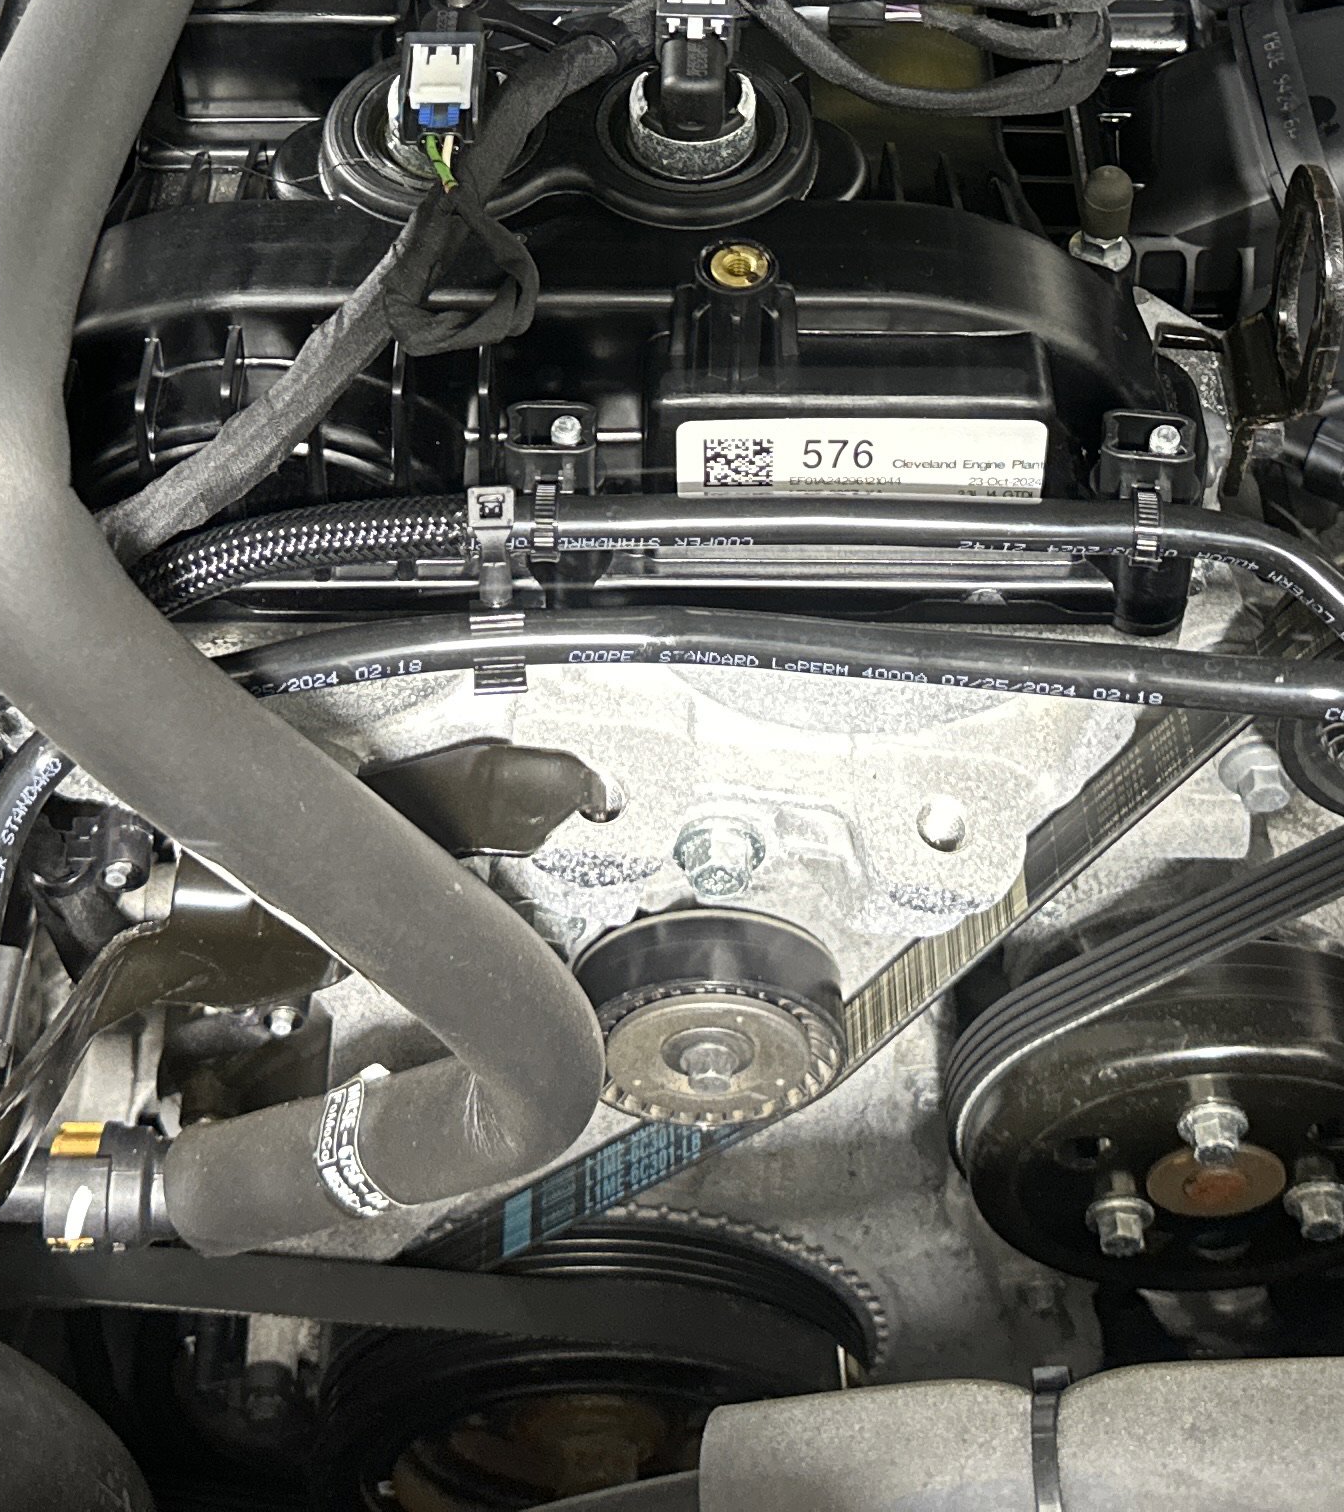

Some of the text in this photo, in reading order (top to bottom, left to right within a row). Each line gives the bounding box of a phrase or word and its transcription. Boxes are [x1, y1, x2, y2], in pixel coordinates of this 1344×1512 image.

[801, 438, 875, 470] 576
[892, 458, 957, 470] Cleveland
[962, 458, 1007, 472] Engine
[354, 659, 423, 681] 02:18
[567, 648, 638, 665] COOPE
[657, 649, 760, 669] STANDARD
[769, 655, 851, 677] LoPERM
[860, 664, 929, 686] 4000A
[940, 672, 1078, 699] 07/25/2024
[1091, 687, 1166, 706] 02:18
[0, 757, 63, 847] STANDARD
